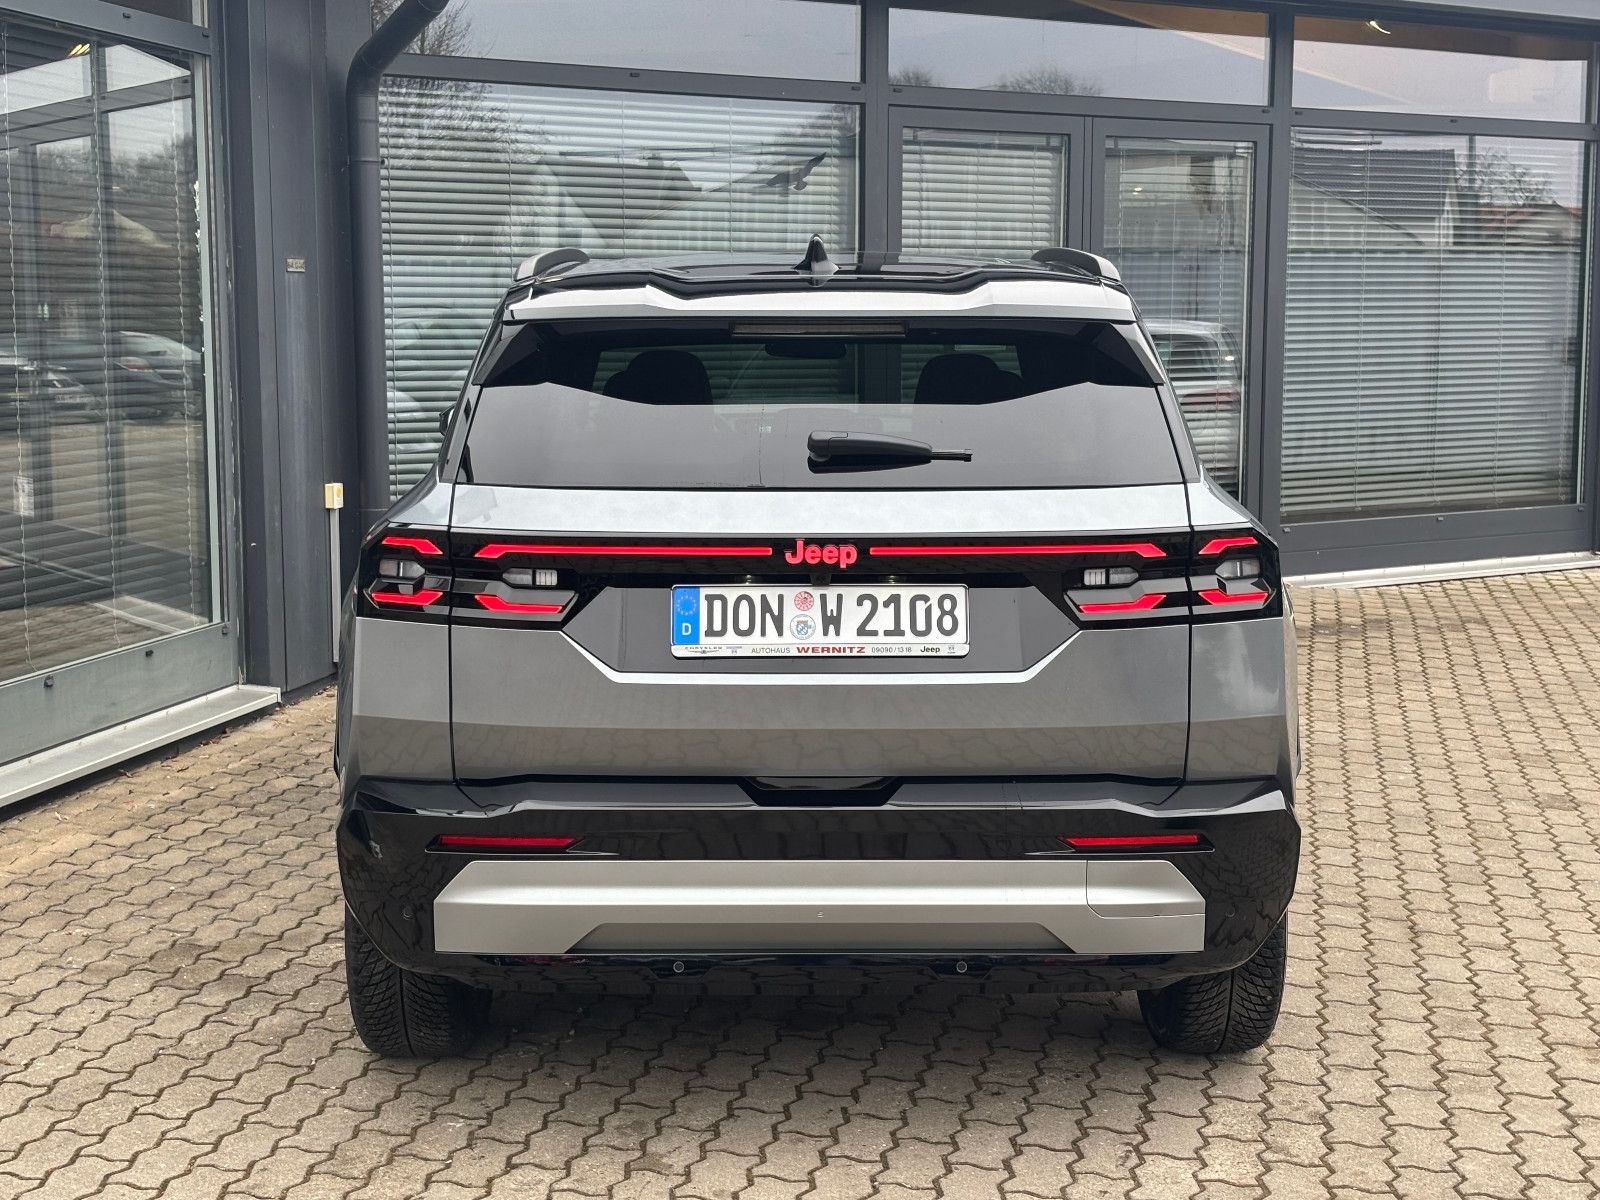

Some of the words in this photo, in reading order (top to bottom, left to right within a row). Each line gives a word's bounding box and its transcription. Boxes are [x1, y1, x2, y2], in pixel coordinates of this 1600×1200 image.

[785, 539, 858, 569] Jeep
[704, 593, 785, 638] DON
[819, 593, 844, 637] W
[856, 593, 959, 637] 2108
[682, 622, 692, 636] D
[796, 646, 866, 654] WERNITZ
[920, 645, 941, 654] Jeep
